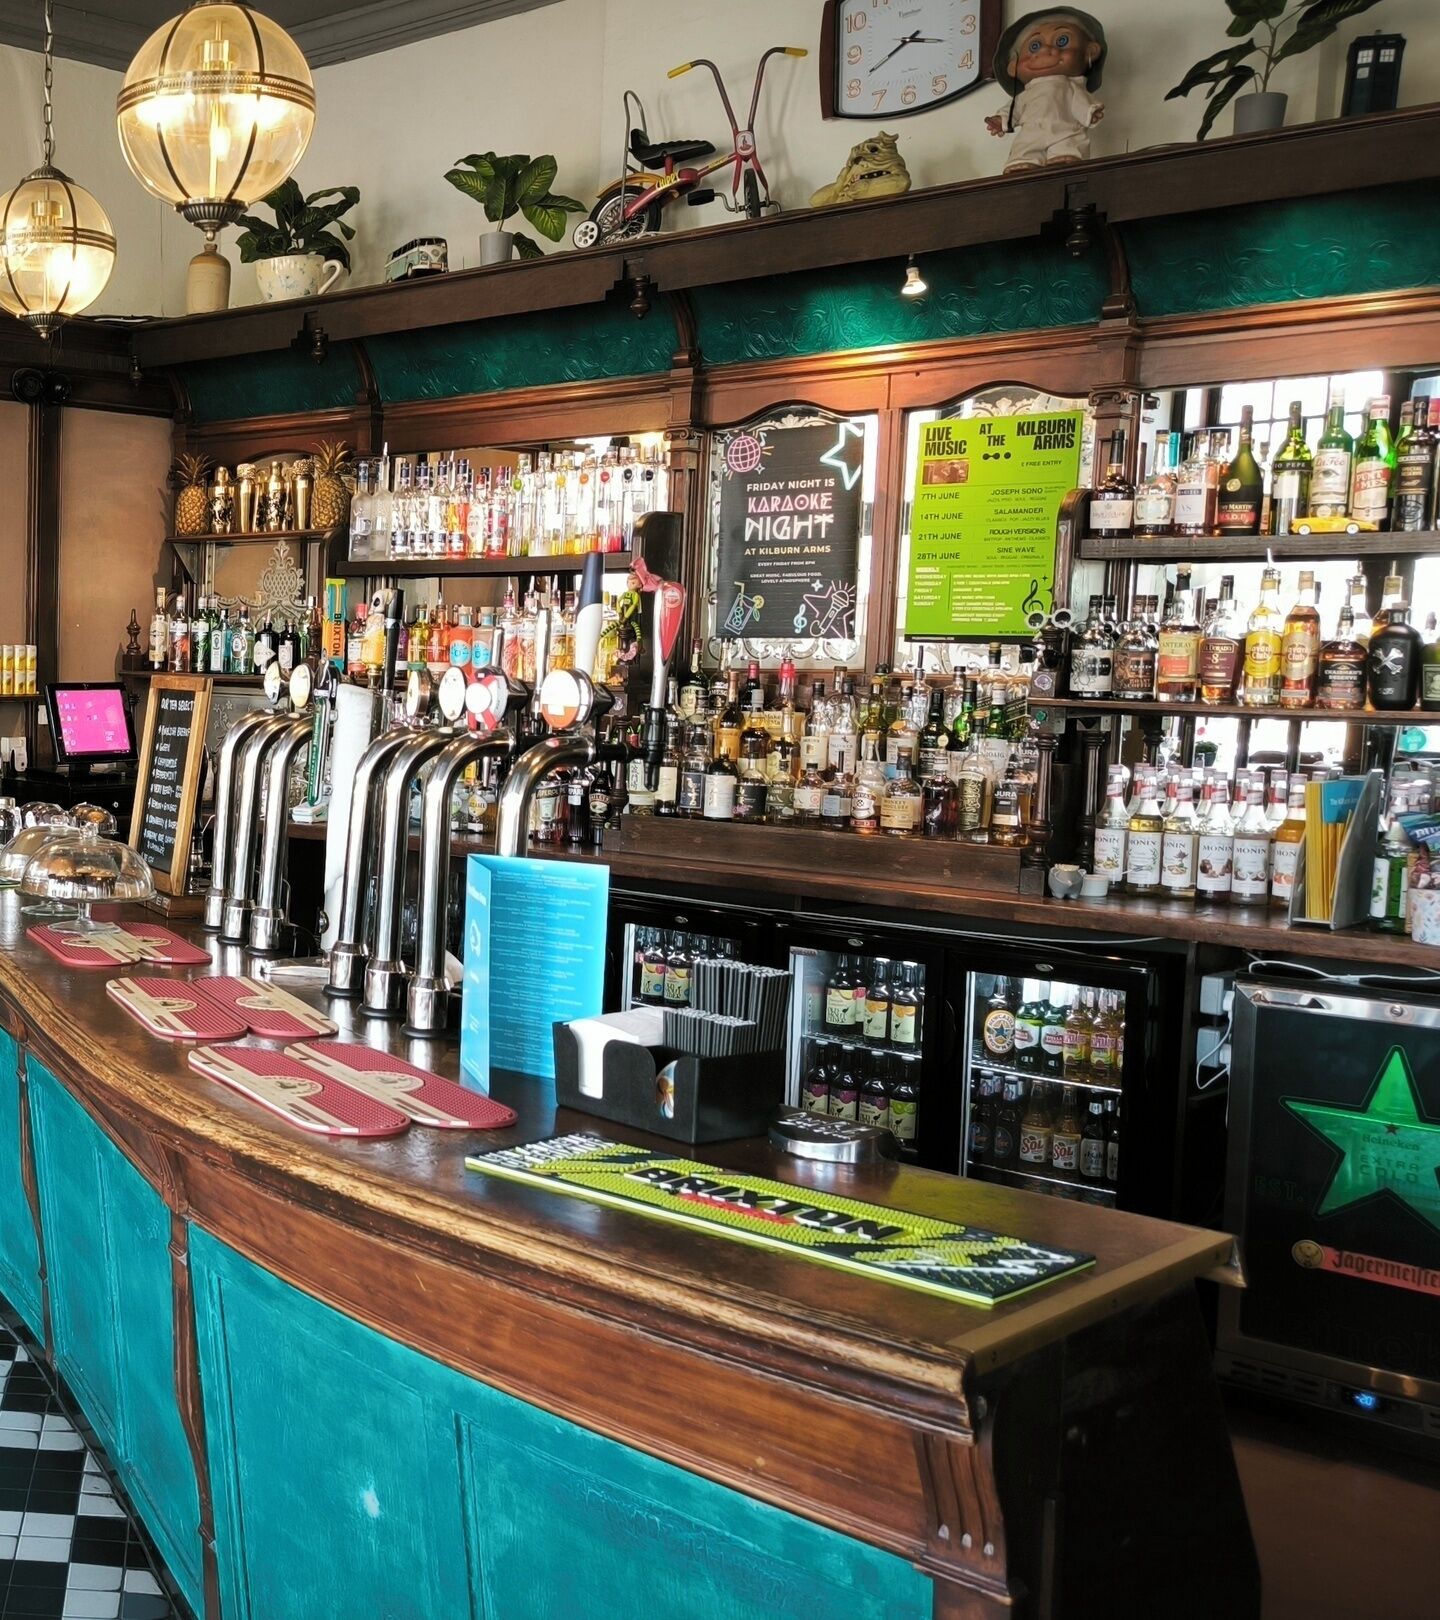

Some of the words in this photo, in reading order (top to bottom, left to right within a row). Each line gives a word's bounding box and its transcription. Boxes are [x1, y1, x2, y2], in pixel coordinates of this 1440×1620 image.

[845, 11, 867, 33] 10
[960, 15, 976, 35] 3
[847, 45, 862, 65] 9
[958, 50, 974, 69] 4
[846, 78, 862, 98] 8
[932, 75, 947, 96] 5
[872, 89, 887, 111] 7
[901, 85, 917, 105] 6
[925, 427, 952, 442] LIVE
[979, 423, 993, 435] AT
[1016, 418, 1076, 437] KILBURN
[924, 440, 967, 456] MUSIC
[987, 435, 1006, 446] THE
[1033, 433, 1075, 450] ARMS
[747, 482, 785, 492] FRIDAY
[788, 479, 821, 490] NIGHT
[824, 478, 835, 487] IS
[991, 488, 1020, 496] JOSEPH
[748, 493, 833, 513] KARAOKE
[938, 492, 960, 500] JUNE
[942, 512, 963, 520] JUNE
[994, 507, 1044, 515] SALAMANDER
[744, 514, 834, 541] NIGHT
[940, 532, 962, 540] JUNE
[744, 548, 756, 556] AT
[759, 546, 800, 555] KILBURN
[803, 545, 831, 553] ARMS
[939, 552, 960, 560] JUNE
[332, 613, 342, 656] BRIXTON
[1211, 654, 1219, 663] 8
[1022, 1136, 1044, 1155] SOL
[1362, 1133, 1420, 1151] Heineken
[1053, 1144, 1073, 1160] SOL
[1360, 1154, 1419, 1172] EXTRA
[1360, 1164, 1419, 1184] COLD
[624, 1167, 904, 1239] BRIXTON
